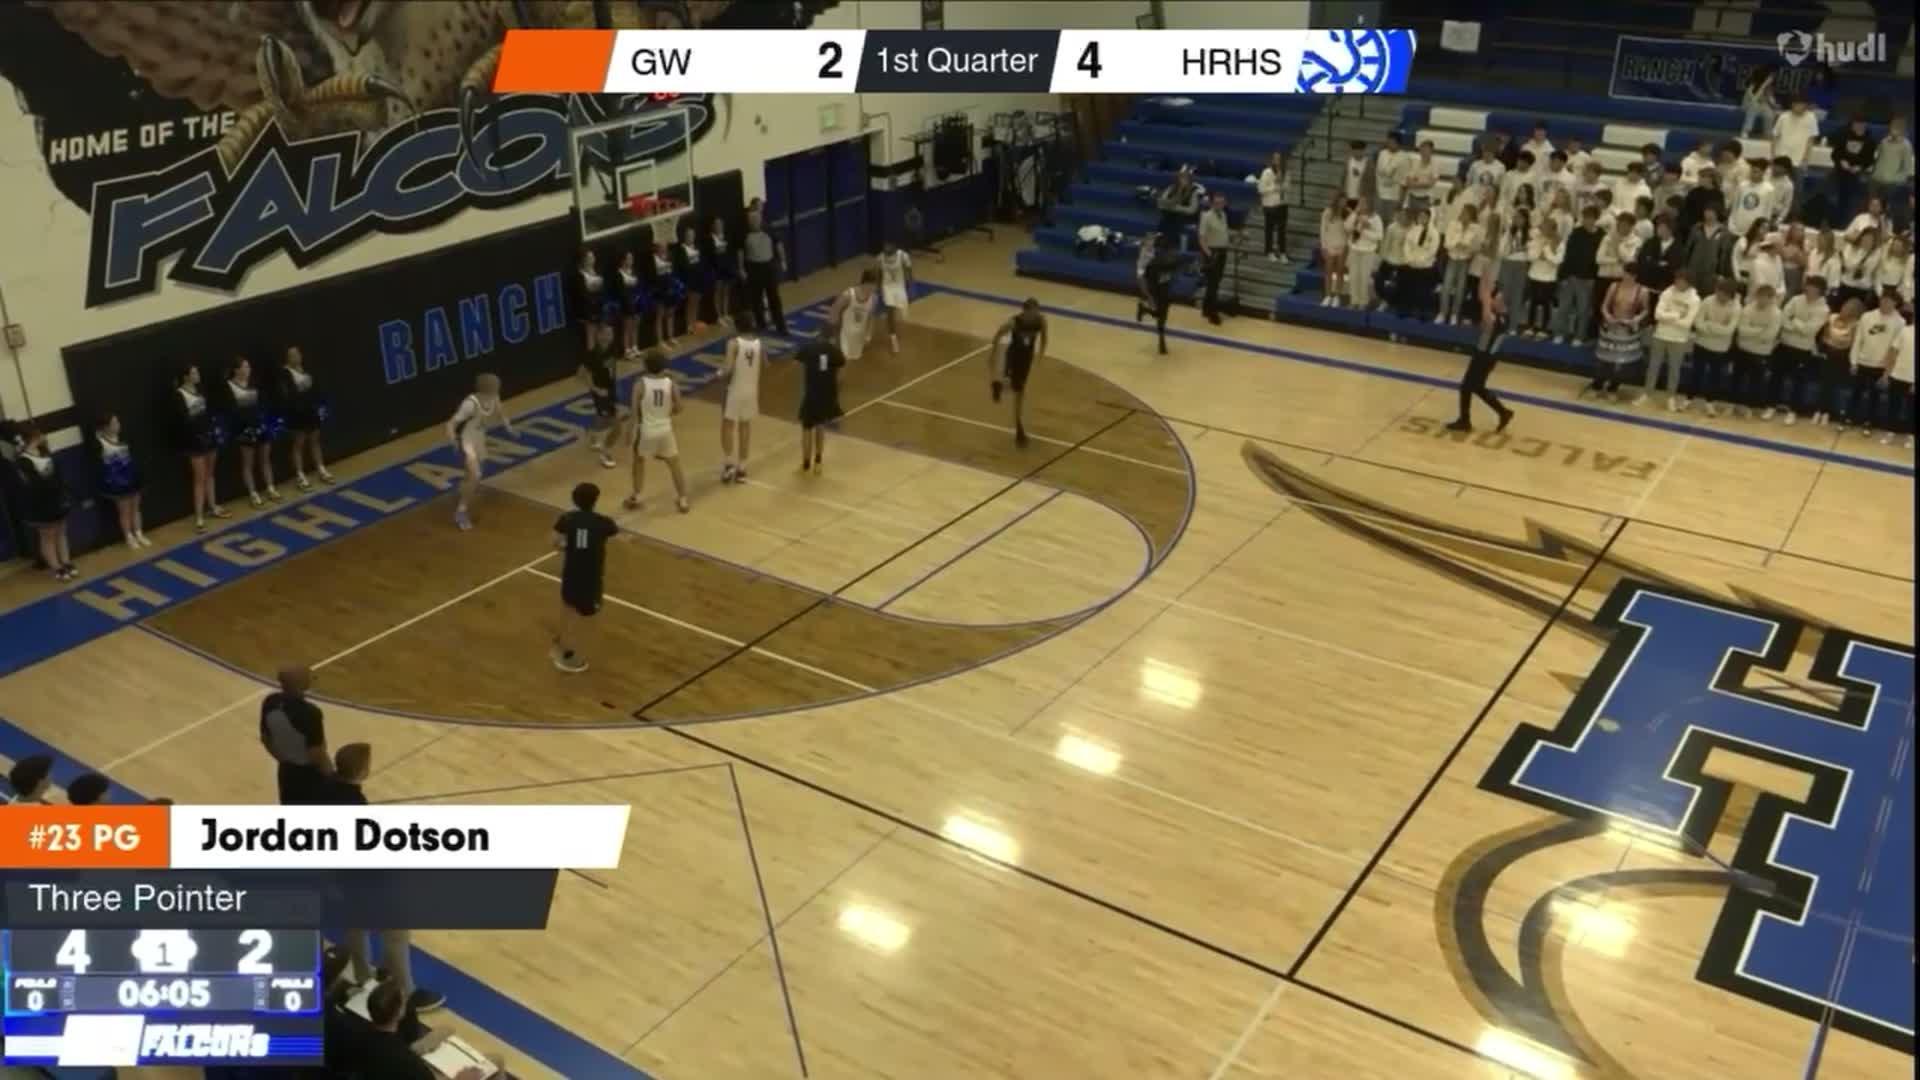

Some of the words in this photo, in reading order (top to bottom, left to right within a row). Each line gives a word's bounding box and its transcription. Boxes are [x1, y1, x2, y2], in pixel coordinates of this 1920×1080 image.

[50, 128, 128, 164] HOME
[139, 121, 174, 148] OF
[183, 111, 236, 141] THE
[379, 271, 567, 385] RANCH
[653, 388, 664, 408] 11
[576, 528, 588, 549] 11
[56, 930, 92, 975] 4
[155, 943, 173, 966] 1
[237, 930, 274, 975] 2
[27, 990, 44, 1011] 0
[117, 978, 212, 1009] 06:05
[284, 990, 302, 1012] 0
